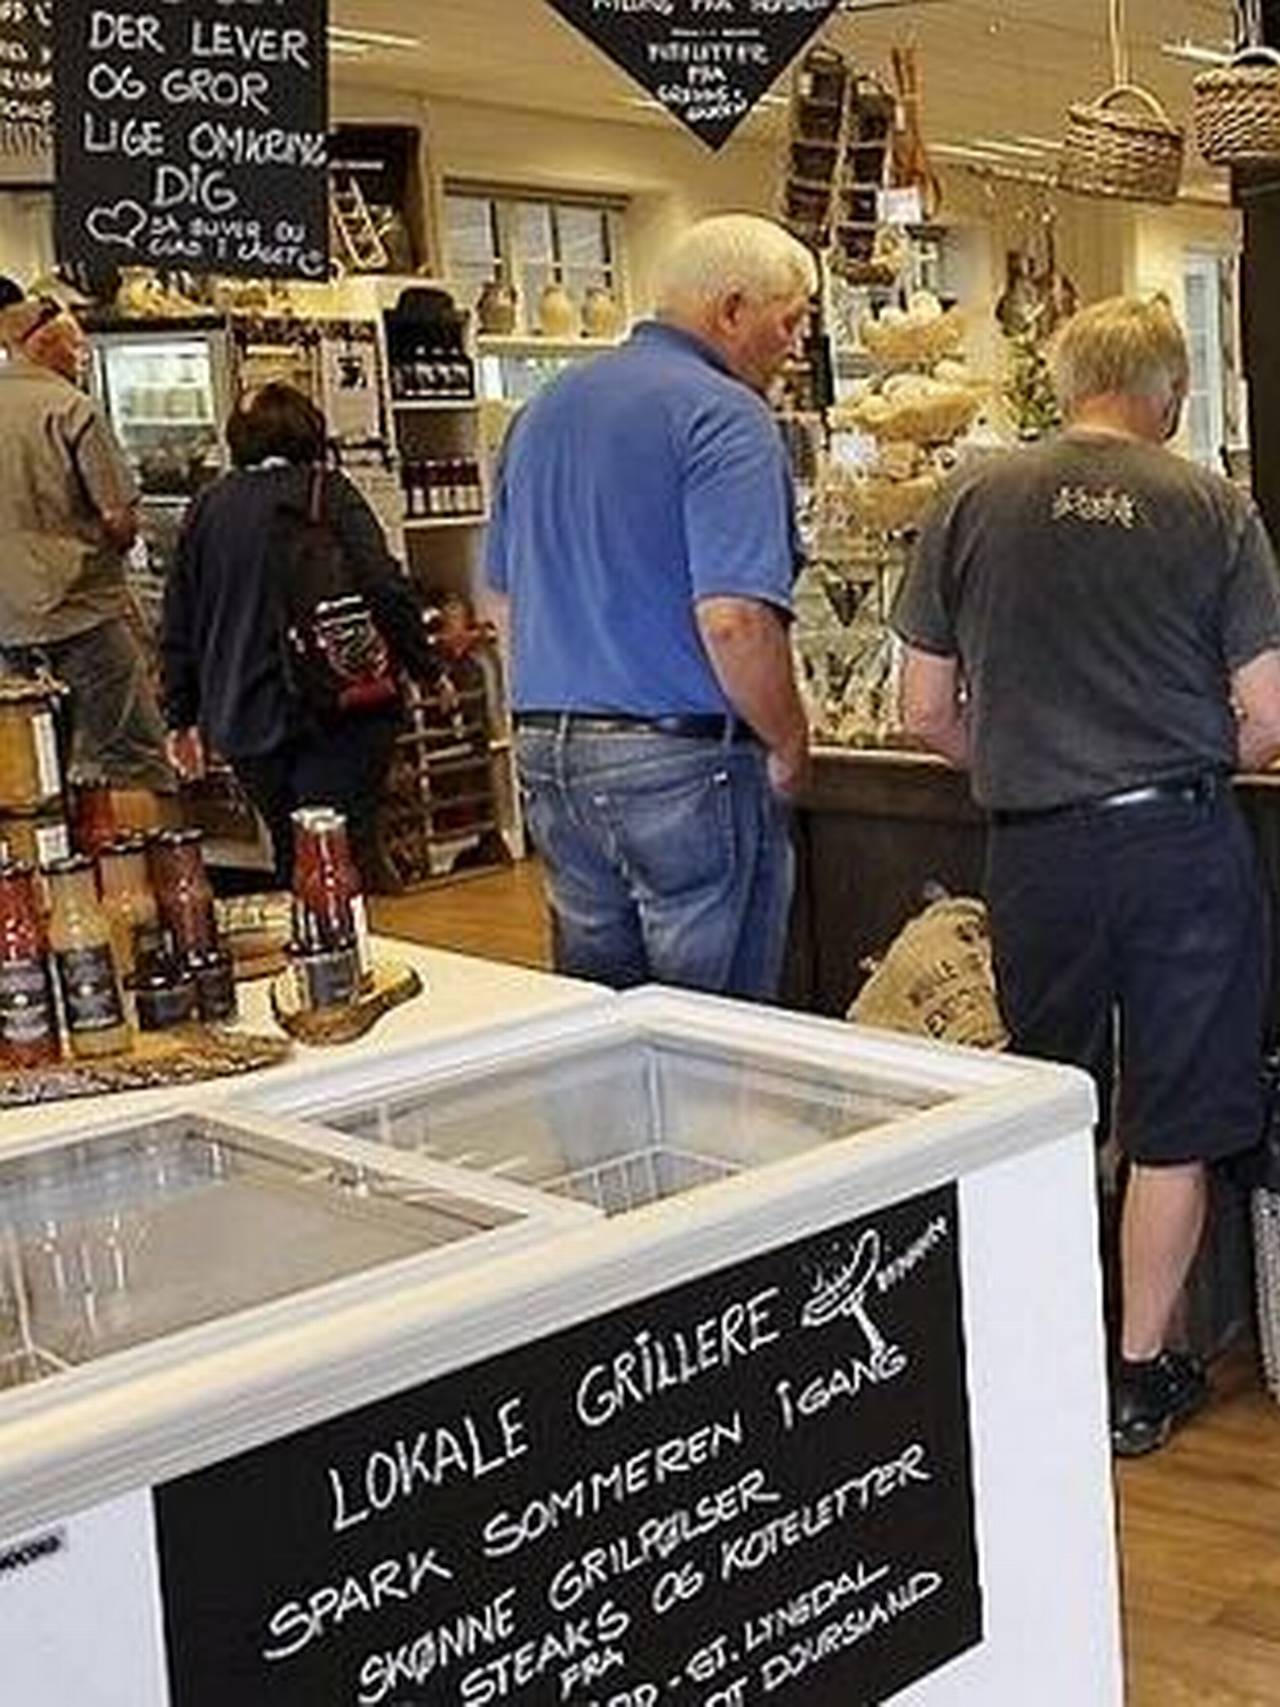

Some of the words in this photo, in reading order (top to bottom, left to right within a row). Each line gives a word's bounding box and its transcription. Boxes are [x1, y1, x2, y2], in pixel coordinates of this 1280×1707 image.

[89, 11, 164, 52] DER
[191, 21, 310, 68] LEVER
[87, 63, 146, 98] OG
[161, 69, 269, 114] GROR
[84, 112, 164, 156] LIGE
[153, 163, 238, 212] DIG
[328, 1397, 529, 1531] LOKALE
[576, 1287, 780, 1427] GRILLERE
[262, 1548, 453, 1661] SPARK
[483, 1410, 743, 1556] SOMMEREN
[357, 1587, 517, 1704] SKØNNE
[549, 1469, 781, 1612] GRILPØLSER
[459, 1601, 631, 1707] STEAKS
[653, 1561, 704, 1613] OG
[721, 1443, 932, 1581] KOTELETTER
[559, 1646, 624, 1700] FRA
